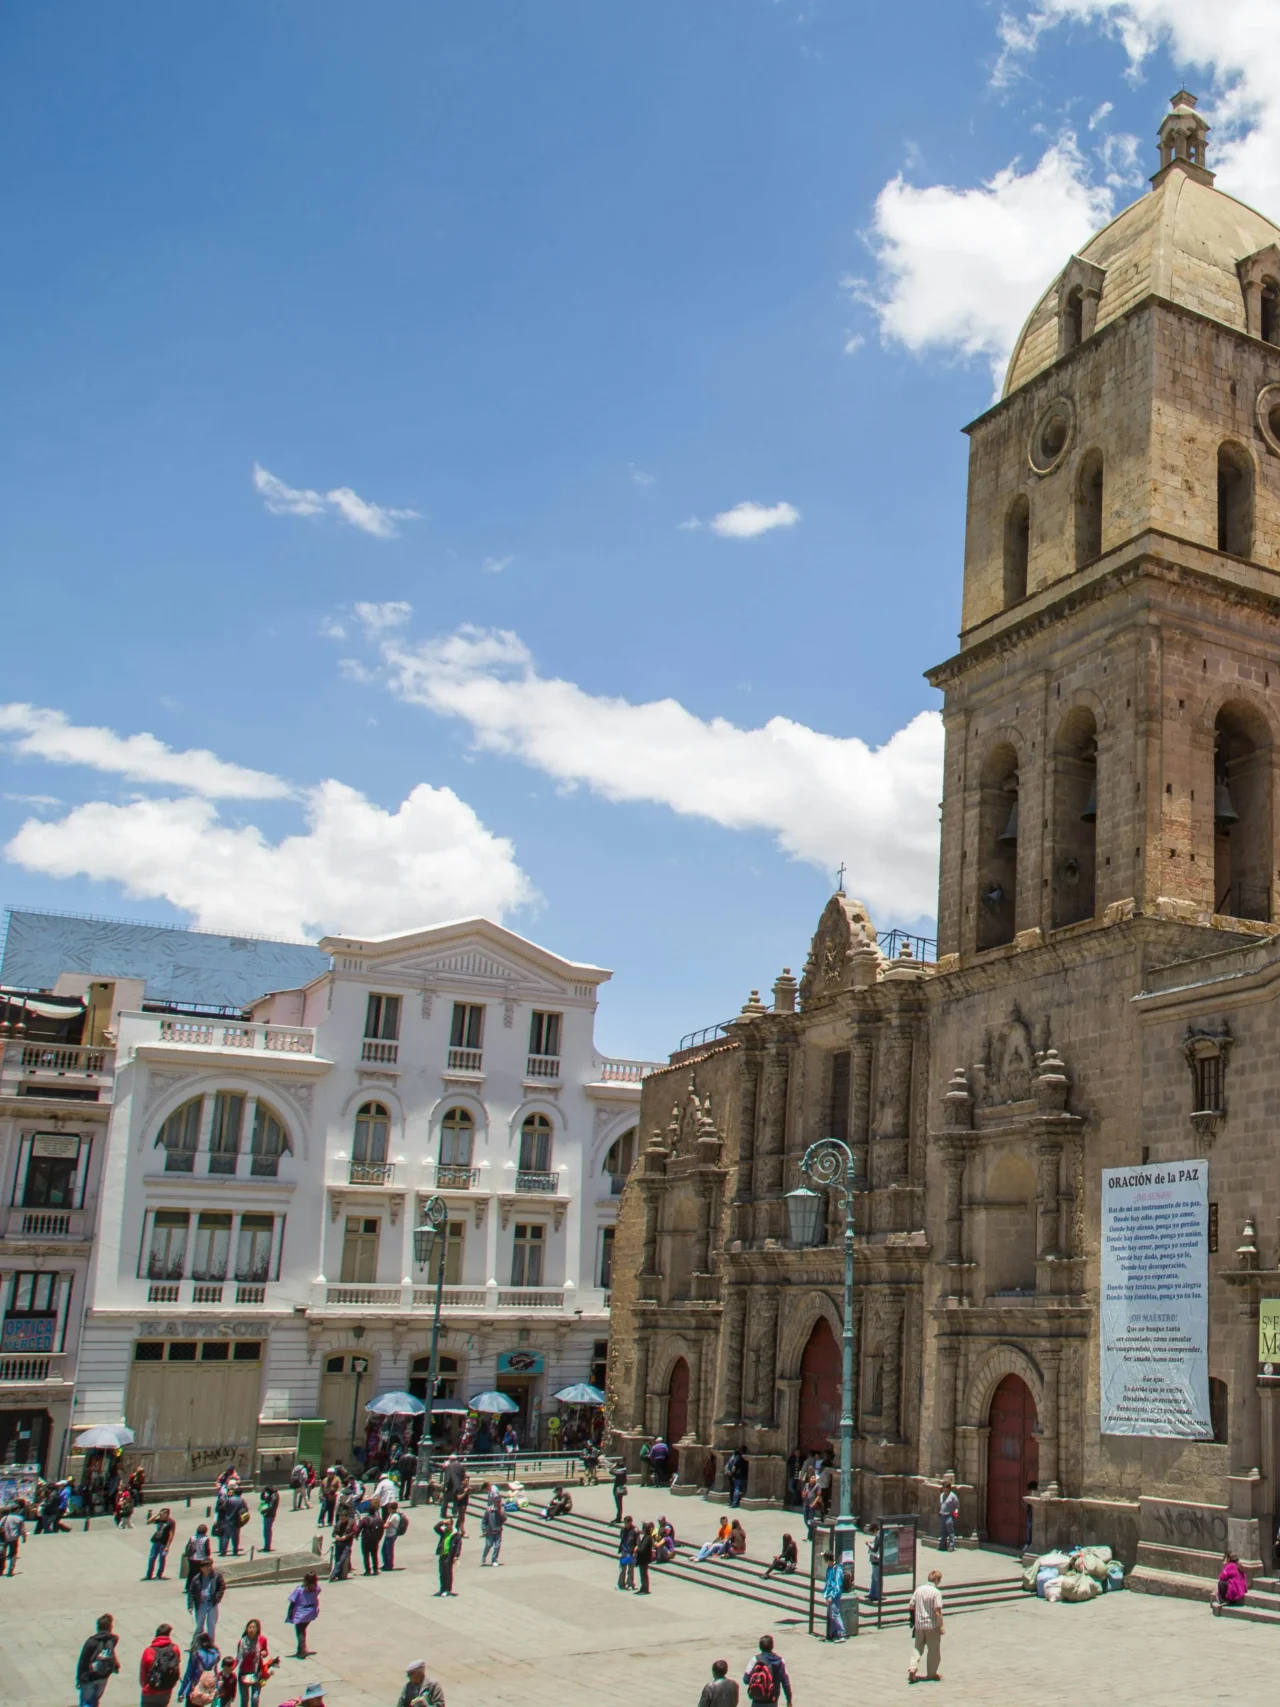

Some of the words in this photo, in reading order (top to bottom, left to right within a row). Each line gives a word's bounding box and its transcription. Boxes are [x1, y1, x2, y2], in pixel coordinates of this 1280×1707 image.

[1108, 1172, 1152, 1188] ORACIÓN
[1154, 1173, 1165, 1184] de
[1168, 1172, 1176, 1183] la
[1178, 1168, 1199, 1182] PAZ
[1142, 1202, 1174, 1211] instrumento
[1126, 1224, 1135, 1232] hay
[1156, 1223, 1172, 1231] ponga
[1124, 1234, 1132, 1242] hay
[1134, 1254, 1142, 1262] hay
[1160, 1253, 1175, 1261] ponga
[1138, 1263, 1147, 1271] hay
[4, 1336, 52, 1350] MERCED
